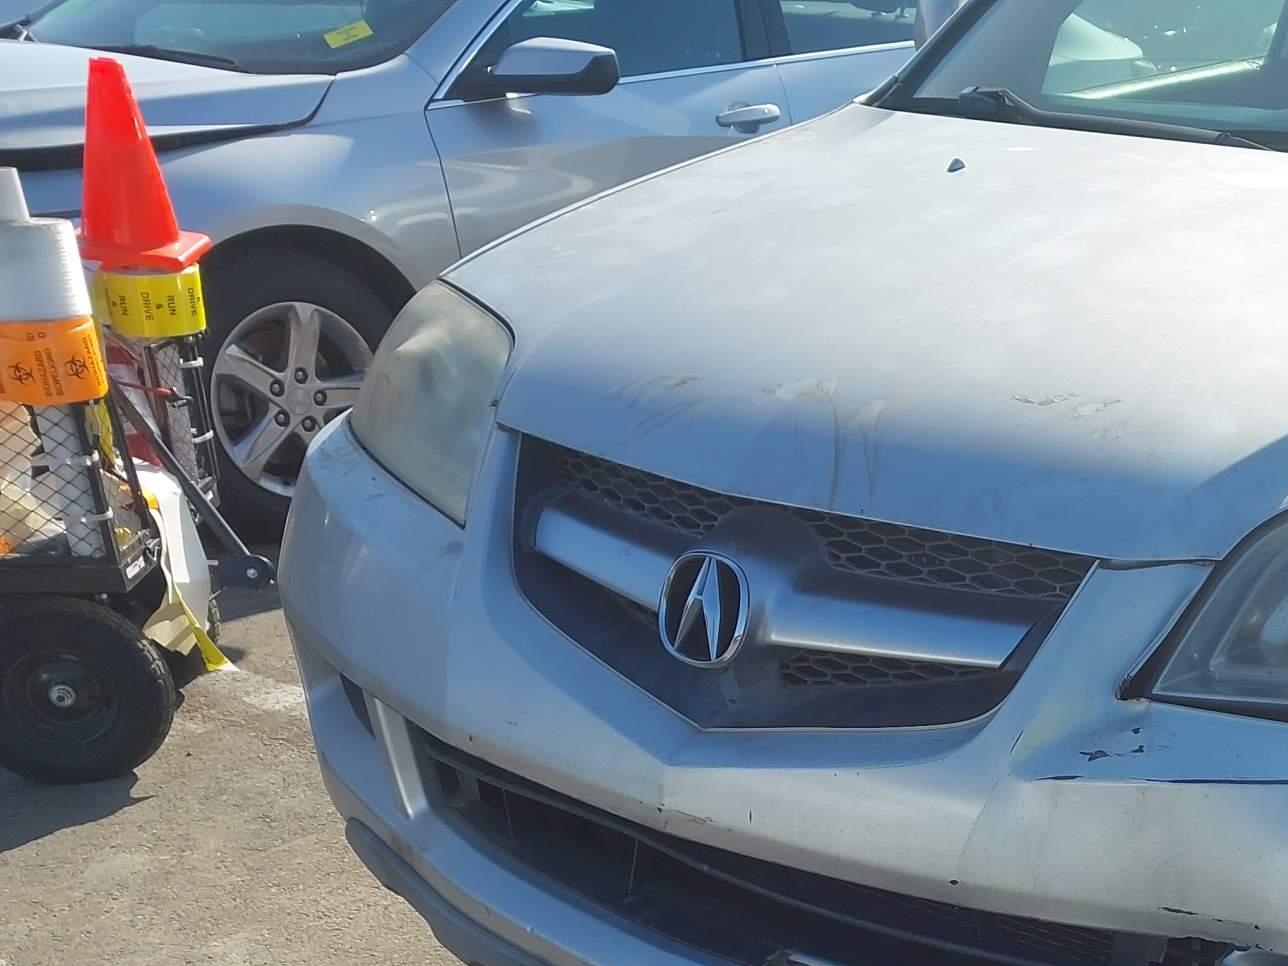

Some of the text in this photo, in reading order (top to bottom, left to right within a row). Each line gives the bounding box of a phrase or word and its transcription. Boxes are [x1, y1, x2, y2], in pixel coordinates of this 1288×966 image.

[118, 294, 129, 317] RUN
[140, 291, 154, 321] DRIVE
[166, 294, 177, 316] RUN
[187, 287, 197, 317] DRIVE
[34, 350, 53, 397] BIOHAZARD
